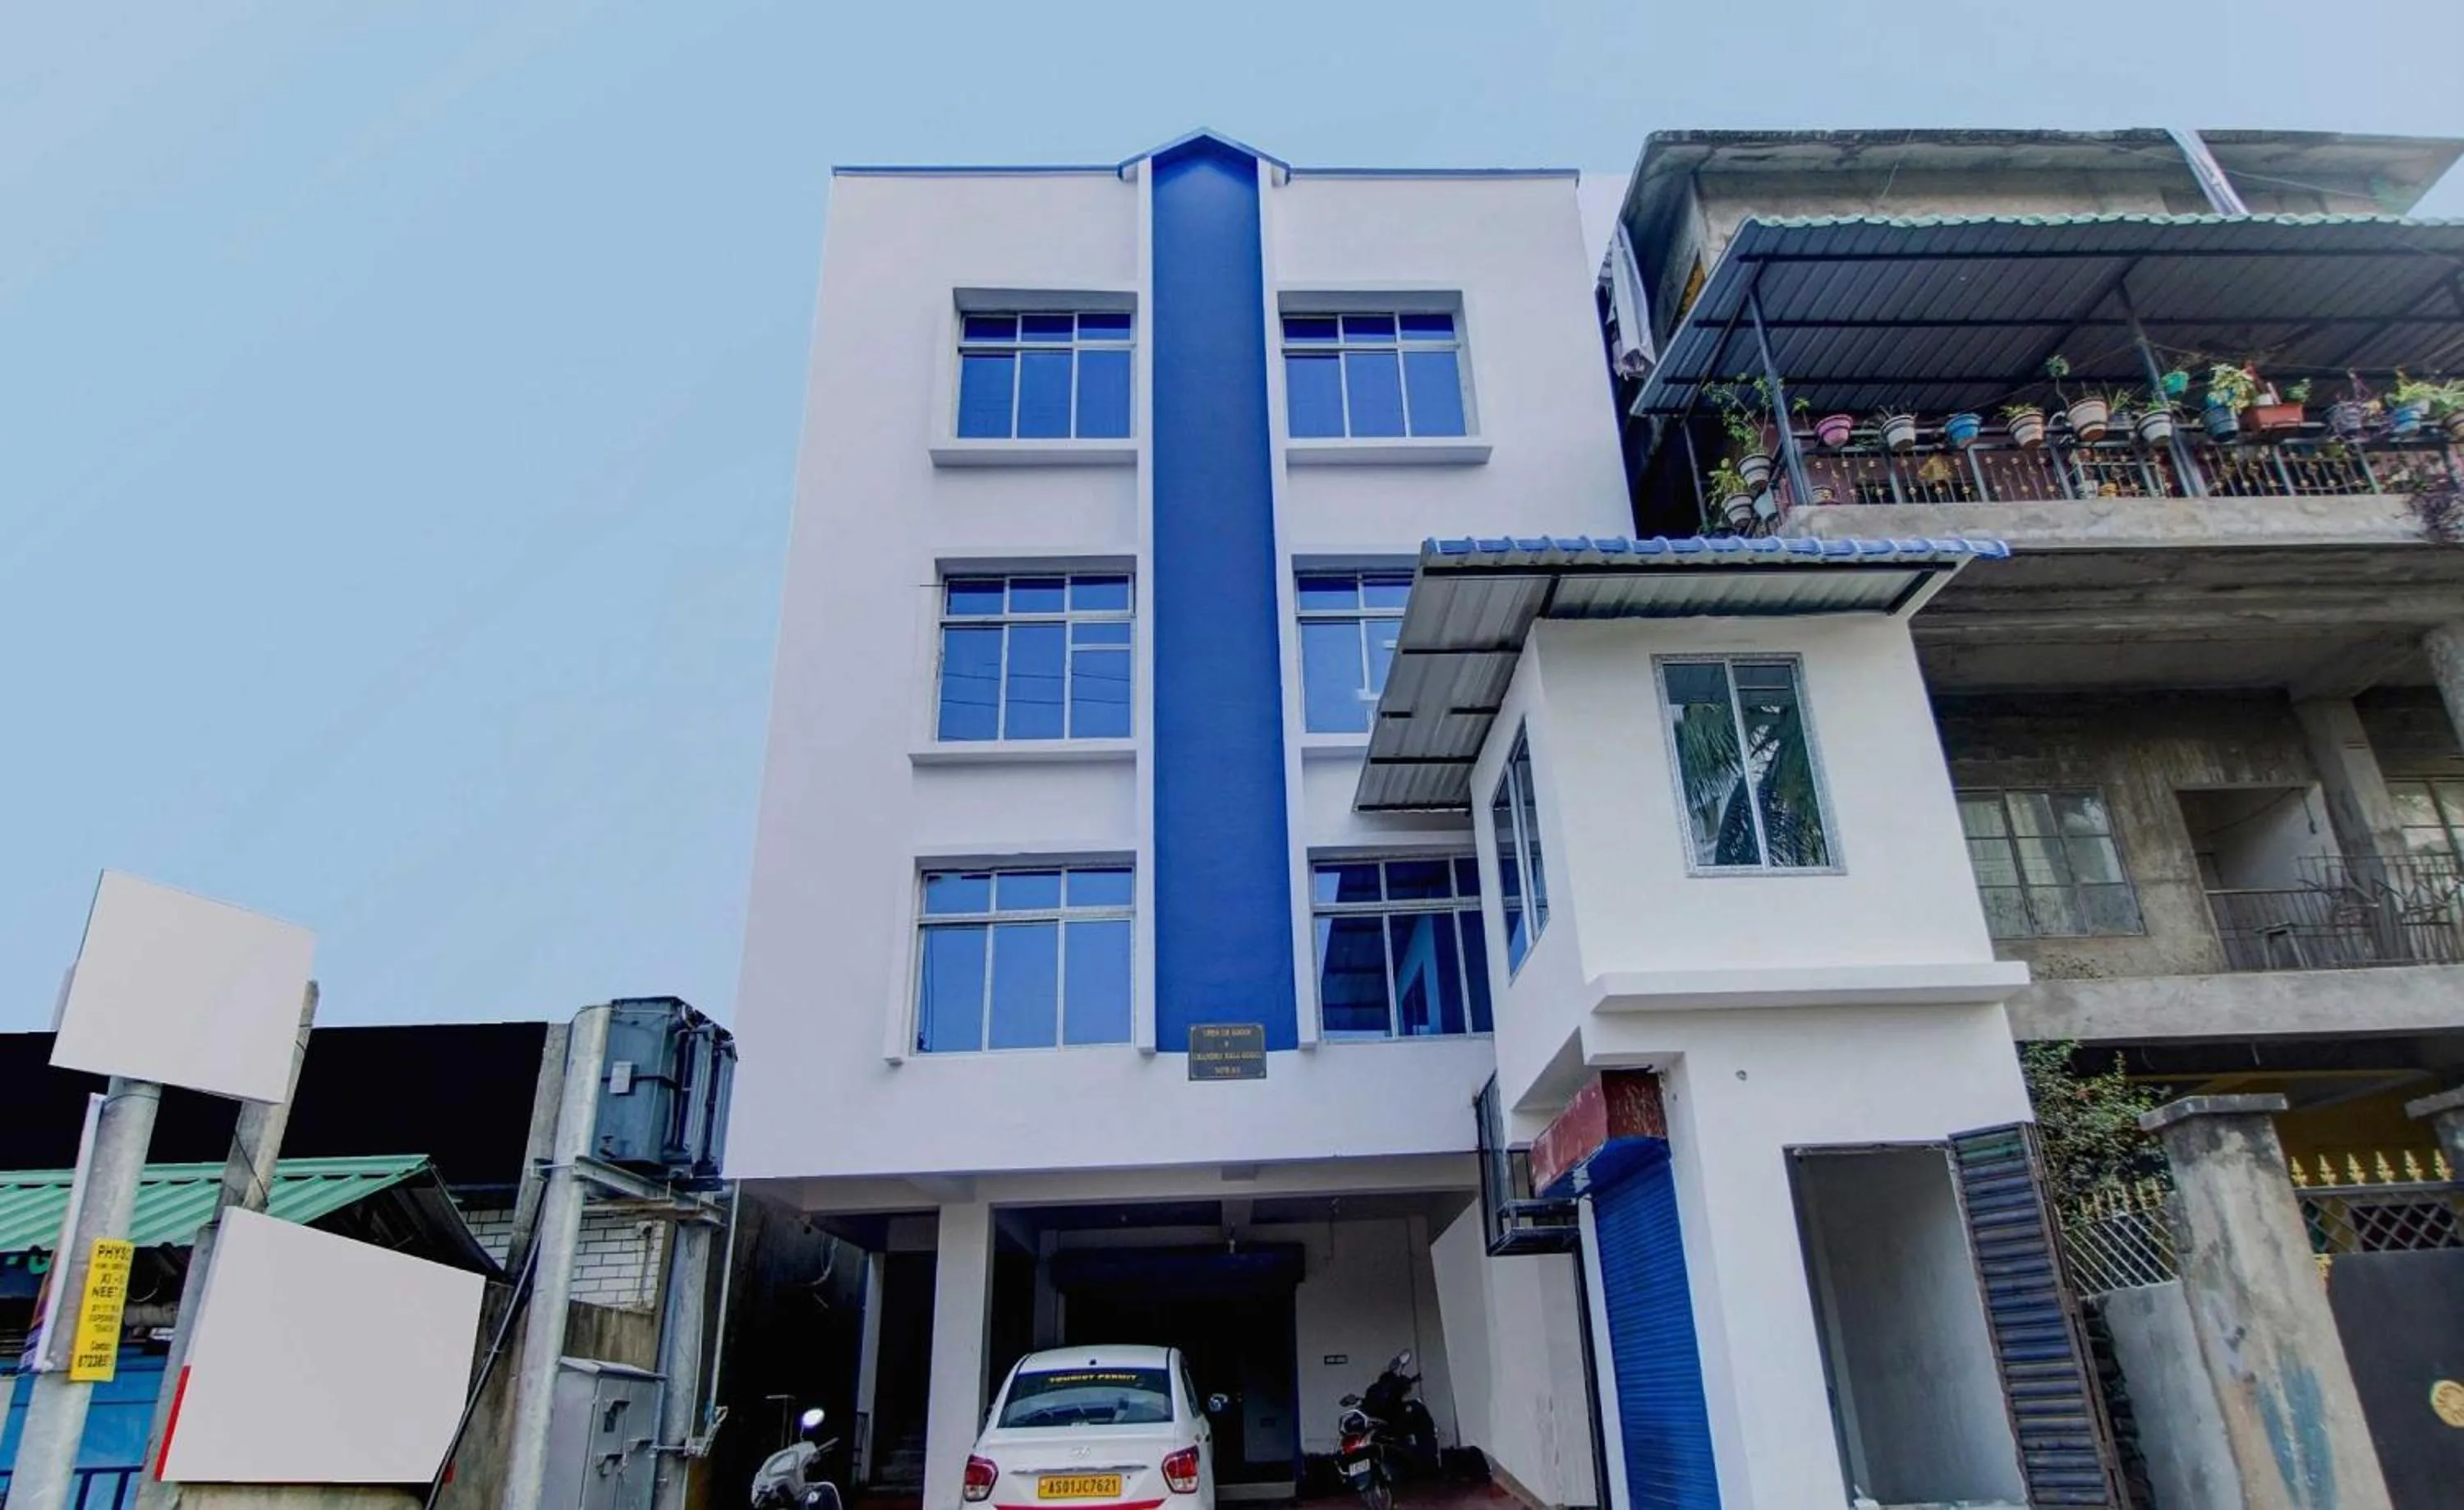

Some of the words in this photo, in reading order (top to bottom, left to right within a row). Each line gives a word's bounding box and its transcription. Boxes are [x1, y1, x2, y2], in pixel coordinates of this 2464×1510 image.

[1049, 1374, 1095, 1383] TOURIST
[1096, 1374, 1138, 1382] PERMIT
[1047, 1478, 1117, 1494] AS01JC7621
